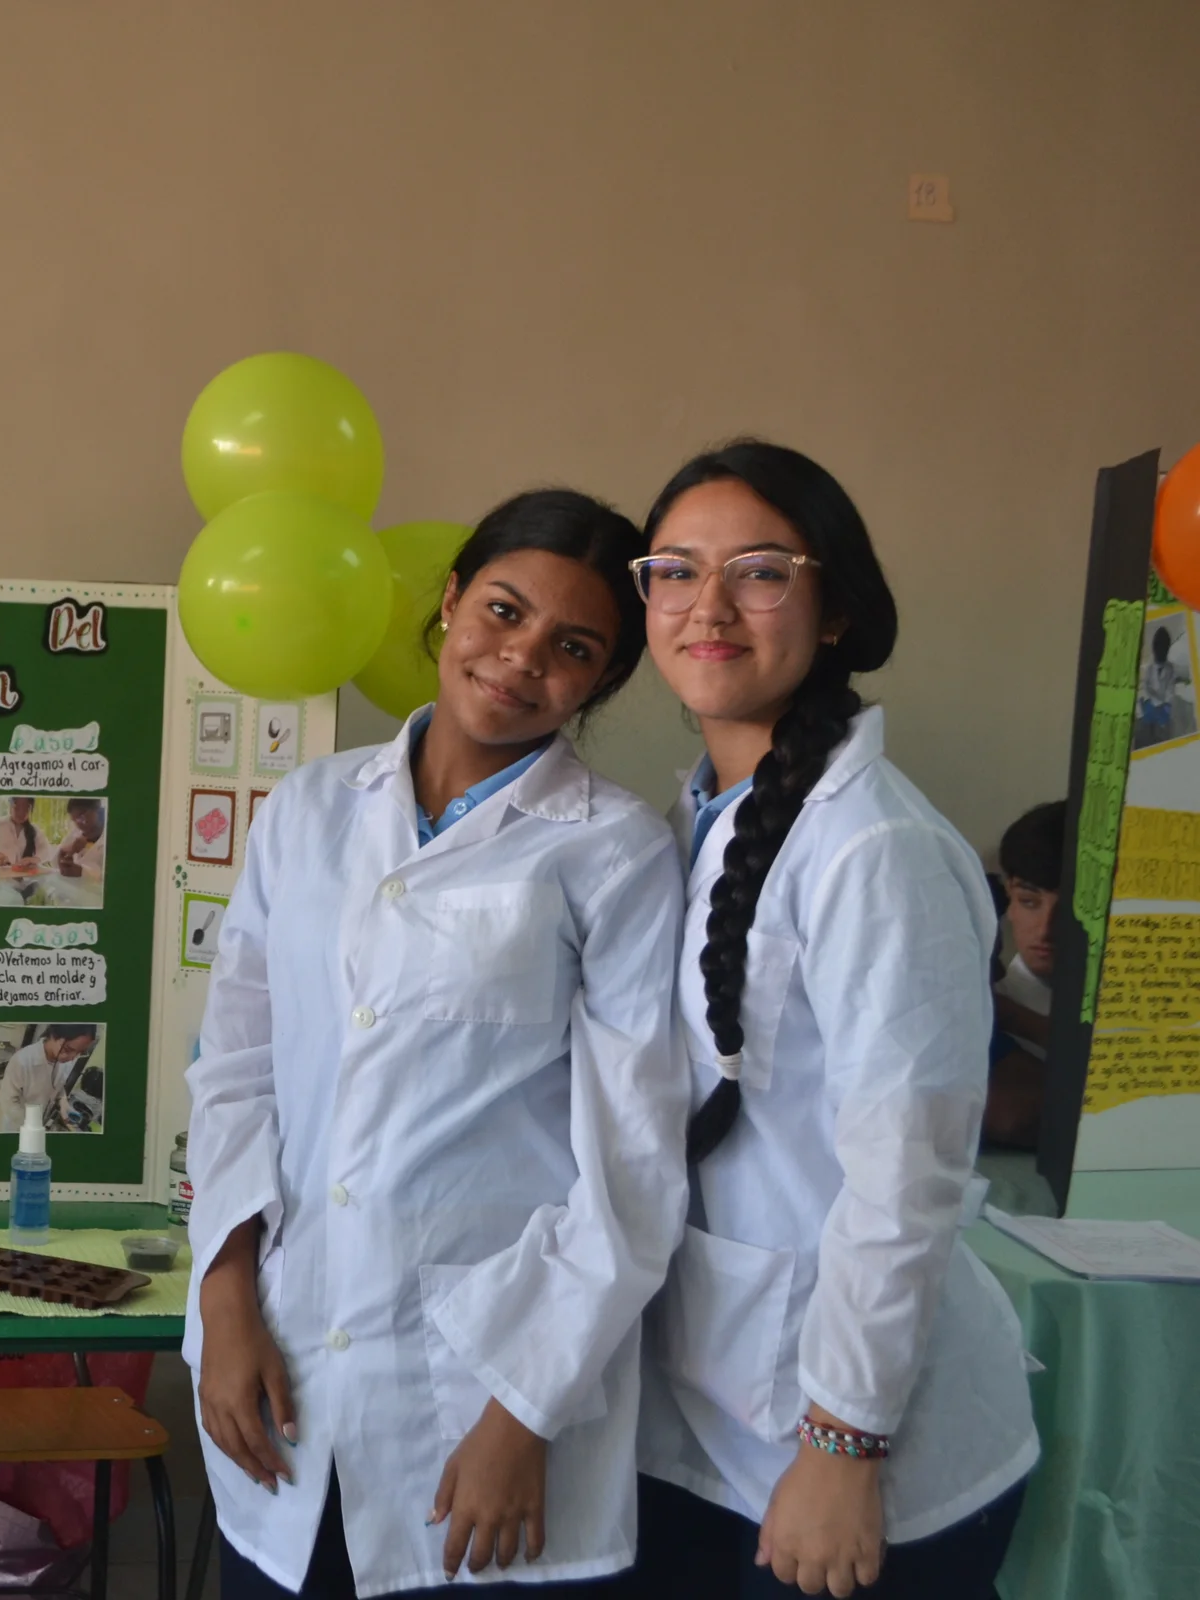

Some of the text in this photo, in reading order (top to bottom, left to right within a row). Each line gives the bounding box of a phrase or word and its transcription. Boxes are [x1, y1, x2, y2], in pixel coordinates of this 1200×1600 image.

[48, 602, 106, 652] Del
[67, 757, 77, 771] el
[19, 772, 74, 788] activado.
[56, 952, 67, 966] la
[21, 974, 34, 985] en
[36, 971, 45, 985] el
[49, 969, 86, 985] molde
[43, 987, 86, 1002] enfriar.
